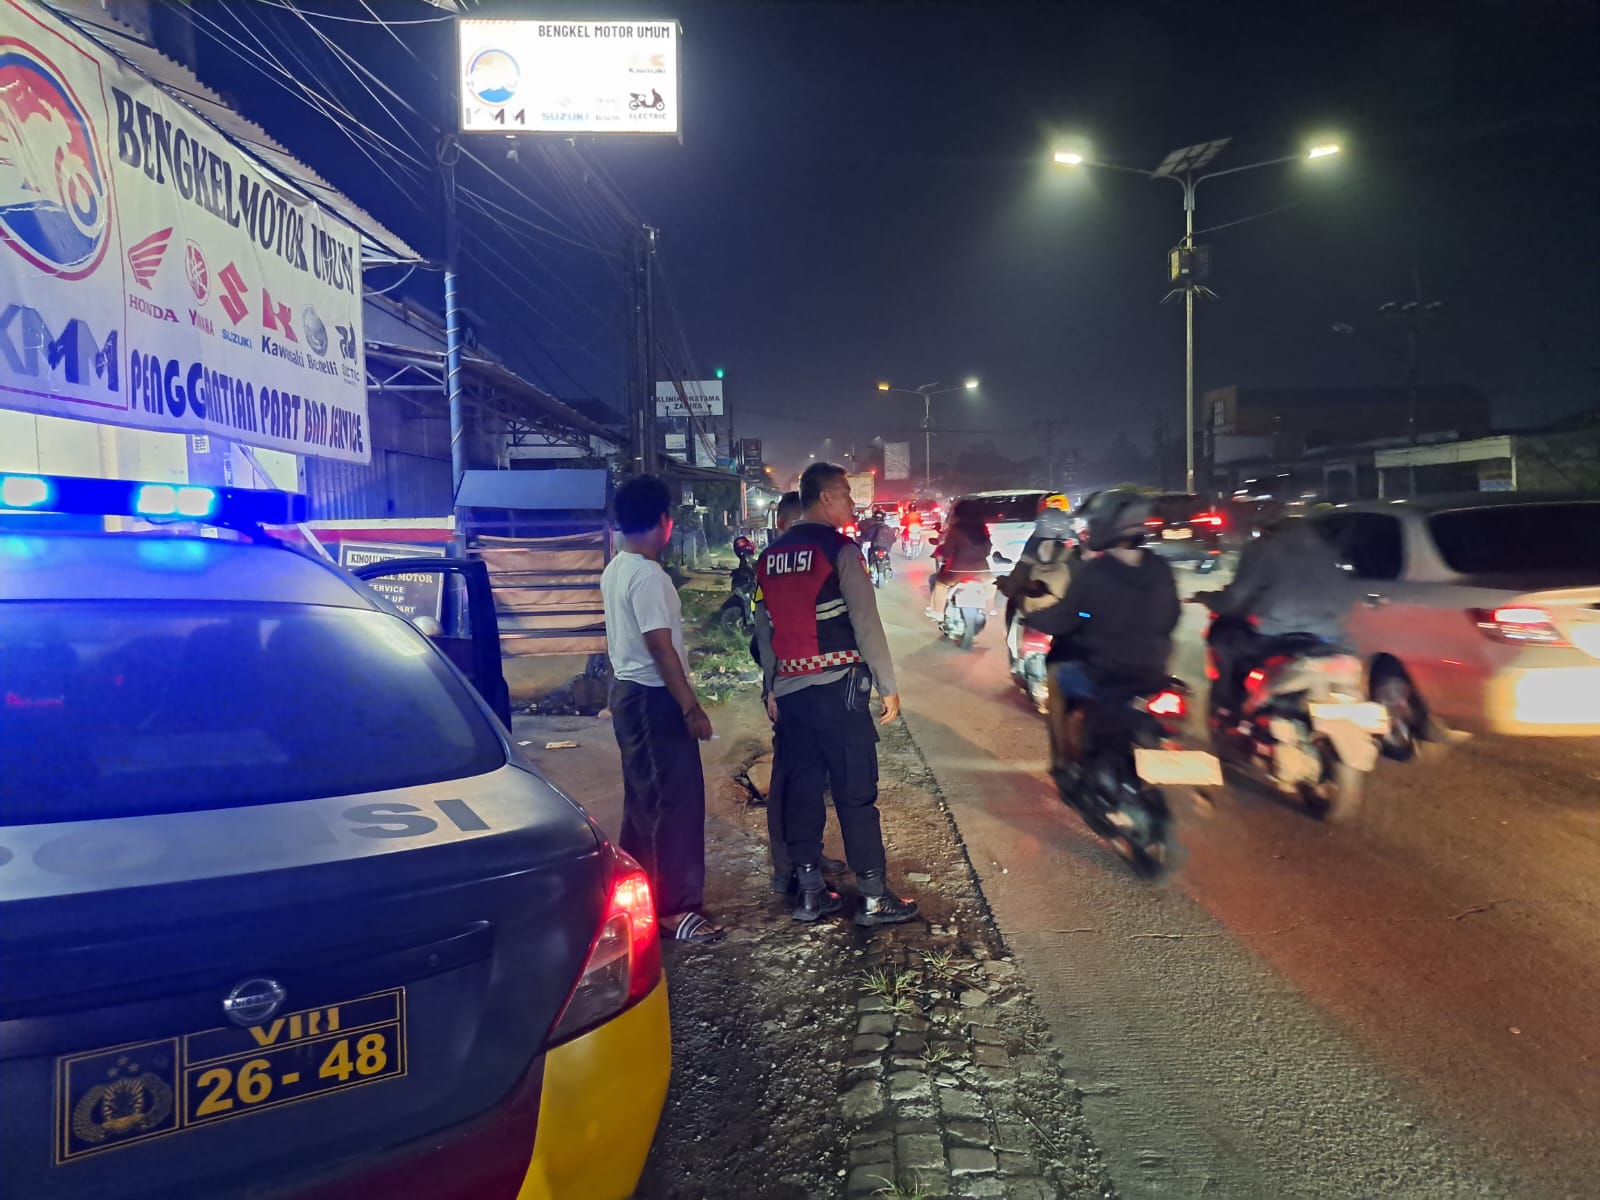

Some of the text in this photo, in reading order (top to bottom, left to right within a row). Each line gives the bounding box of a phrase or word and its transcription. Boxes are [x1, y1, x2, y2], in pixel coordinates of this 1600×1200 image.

[538, 25, 670, 38] BENGKEL MOTOR UMUM
[541, 112, 589, 121] SUZUKI
[112, 86, 240, 228] BENGKEL
[129, 294, 180, 323] HONDA
[222, 328, 253, 349] SUZUKI
[261, 334, 305, 367] Kawasaki
[306, 353, 338, 376] Benelli
[130, 349, 258, 433] PENGGANTIAN
[259, 386, 302, 441] PART
[329, 405, 363, 453] SERVICE
[766, 550, 813, 575] POLISI
[369, 583, 404, 593] ERVICE
[398, 573, 433, 583] MOTOR
